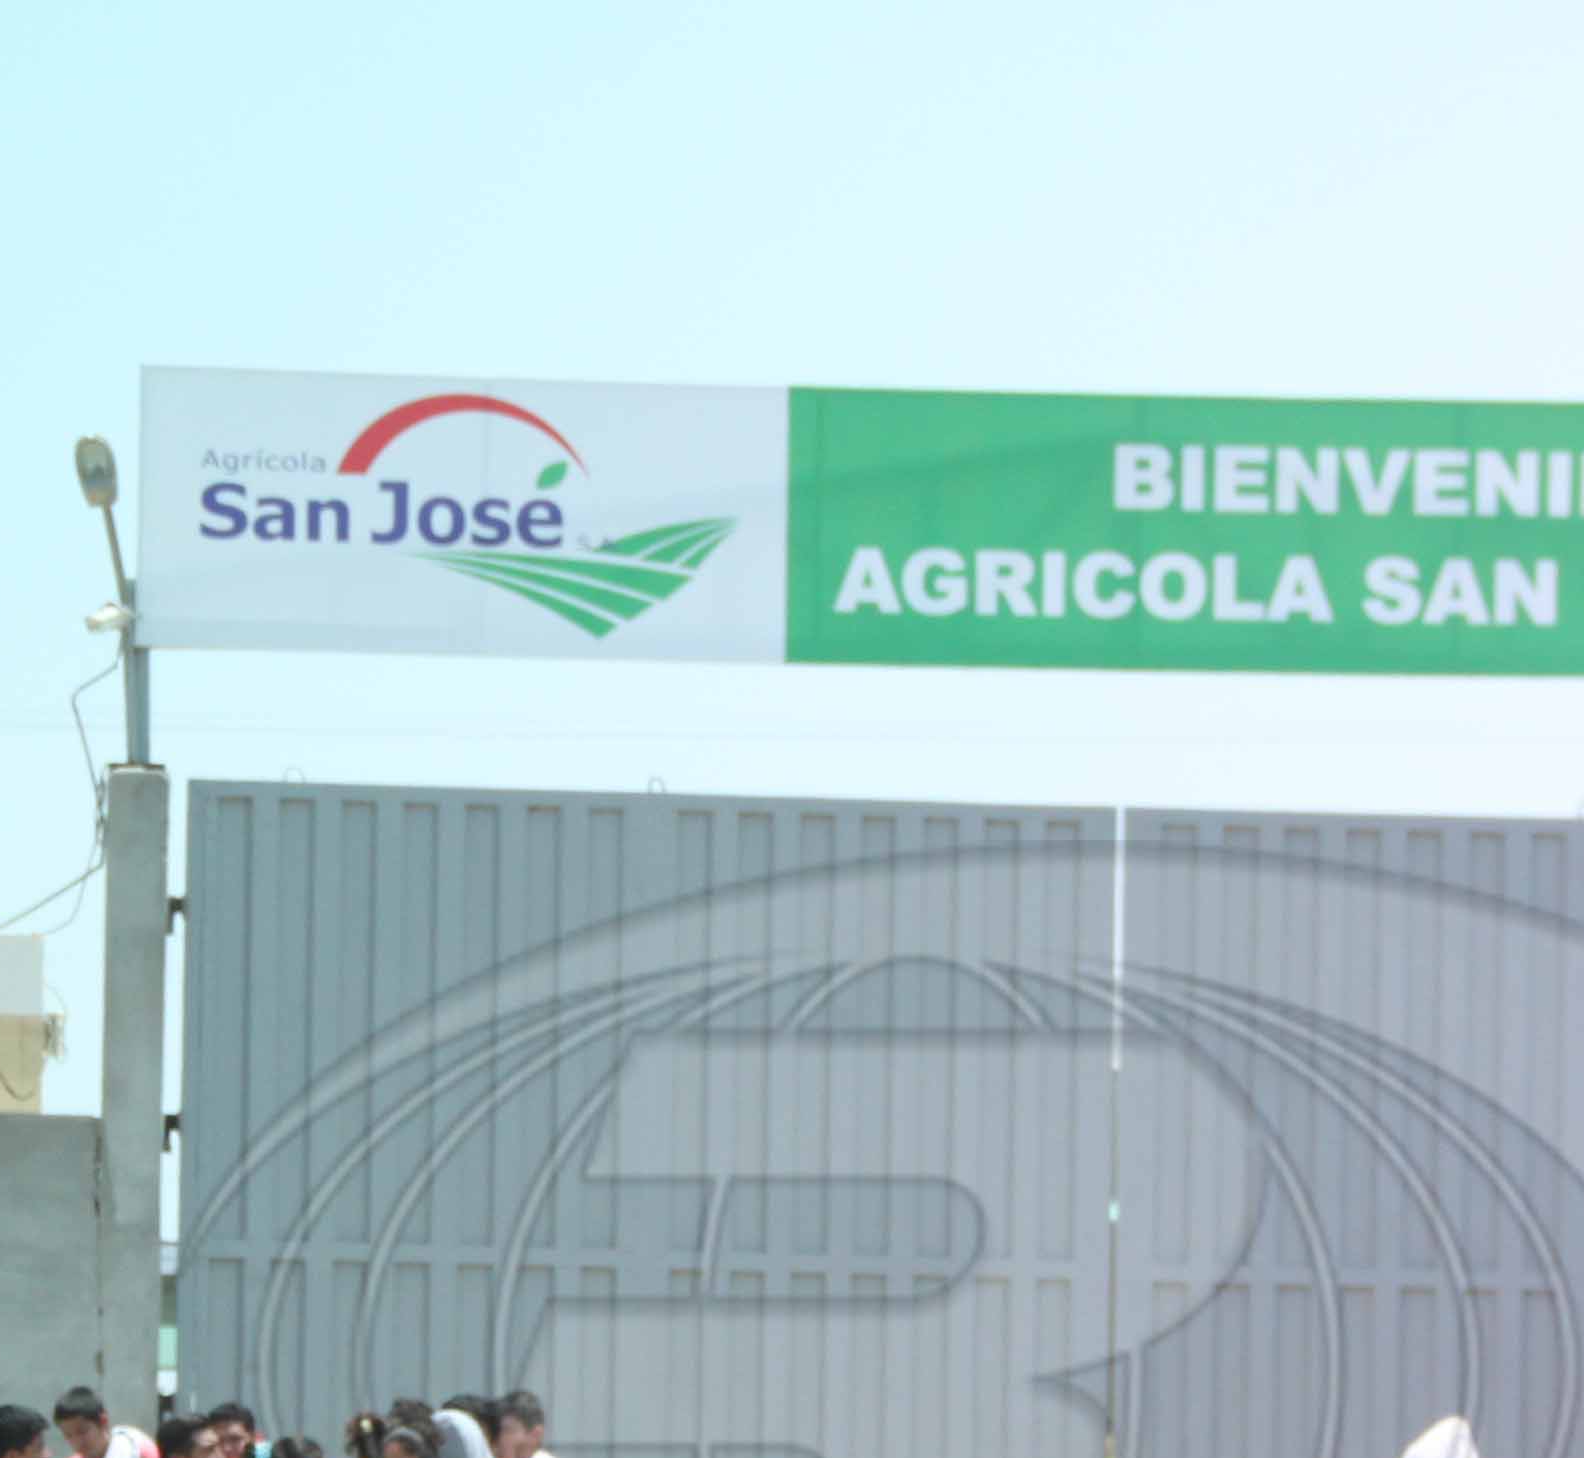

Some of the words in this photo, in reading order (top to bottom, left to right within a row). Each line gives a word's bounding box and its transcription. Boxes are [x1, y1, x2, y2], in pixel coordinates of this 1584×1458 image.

[198, 480, 352, 543] San
[833, 546, 1335, 624] AGRICOLA
[1361, 554, 1561, 628] SAN
